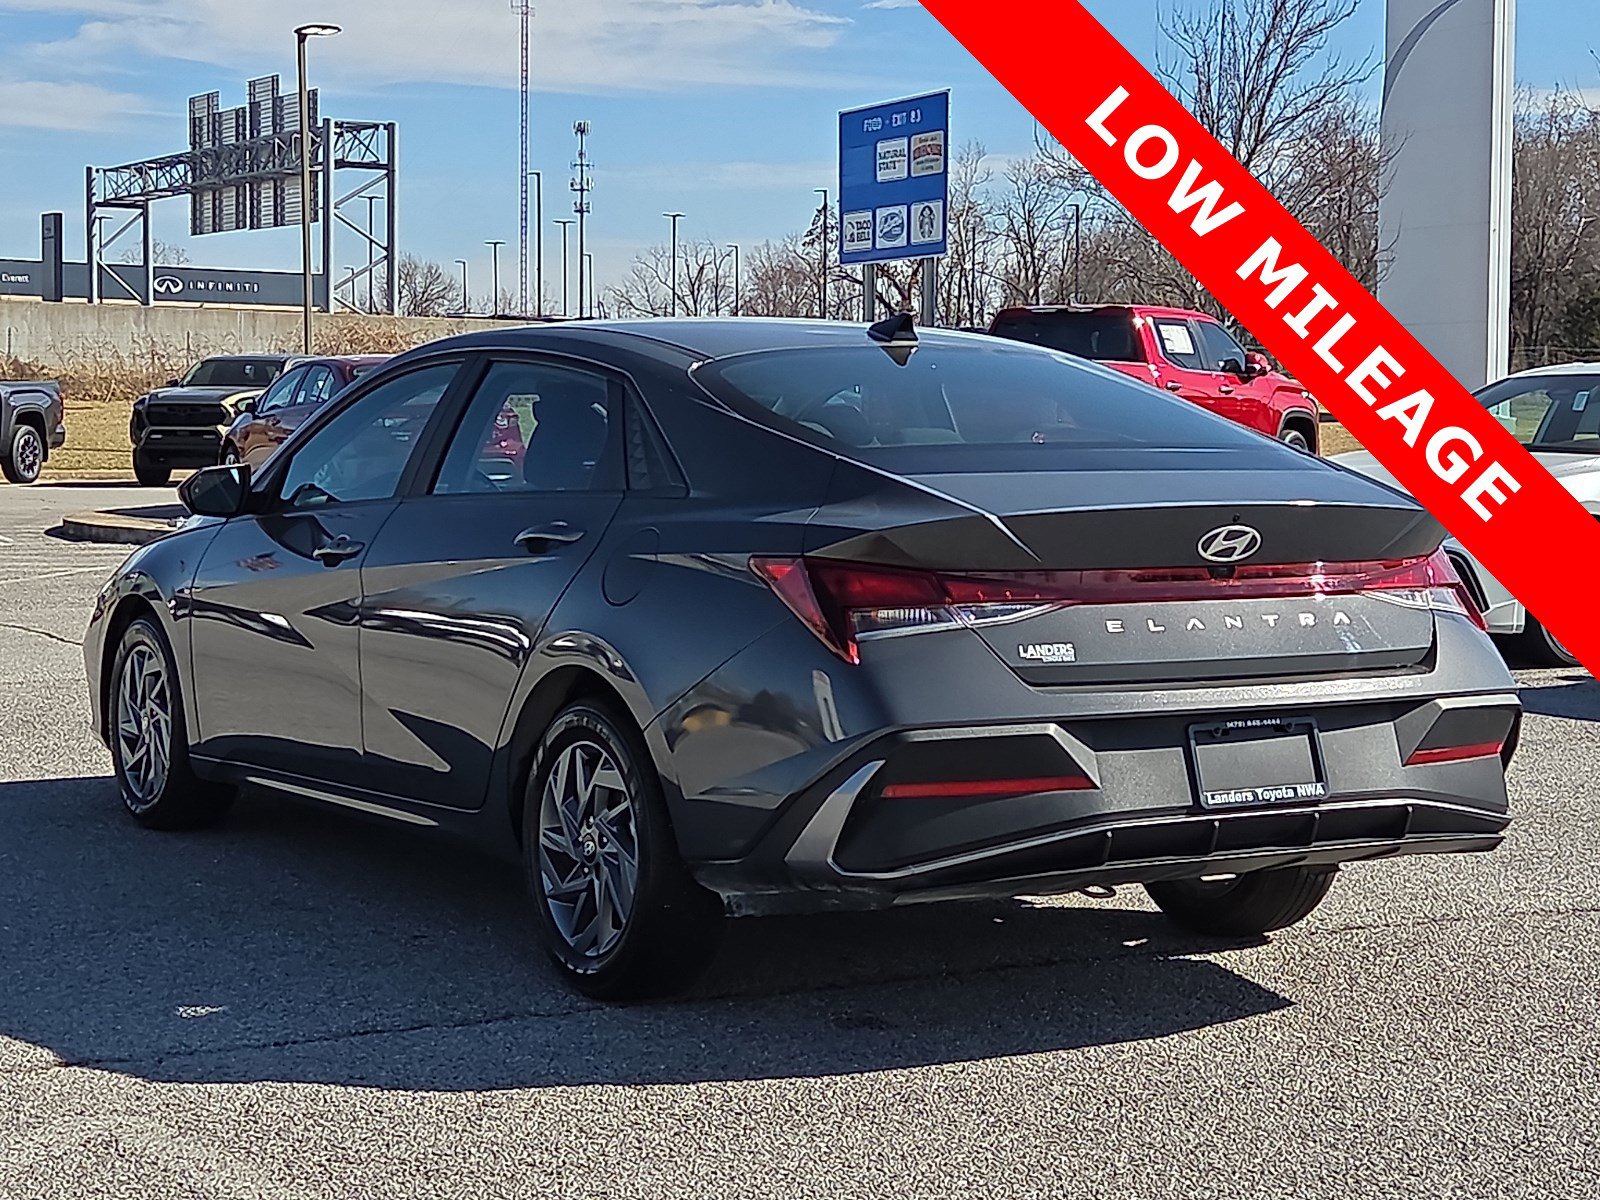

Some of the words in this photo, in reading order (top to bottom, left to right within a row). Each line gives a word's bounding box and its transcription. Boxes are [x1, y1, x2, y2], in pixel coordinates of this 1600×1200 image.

[189, 280, 259, 293] INFINITI
[1105, 611, 1352, 634] ELANTRA
[1018, 643, 1075, 659] LANDERS
[1205, 790, 1255, 805] Landers
[1254, 786, 1295, 802] Toyota
[1296, 783, 1325, 797] NWA
